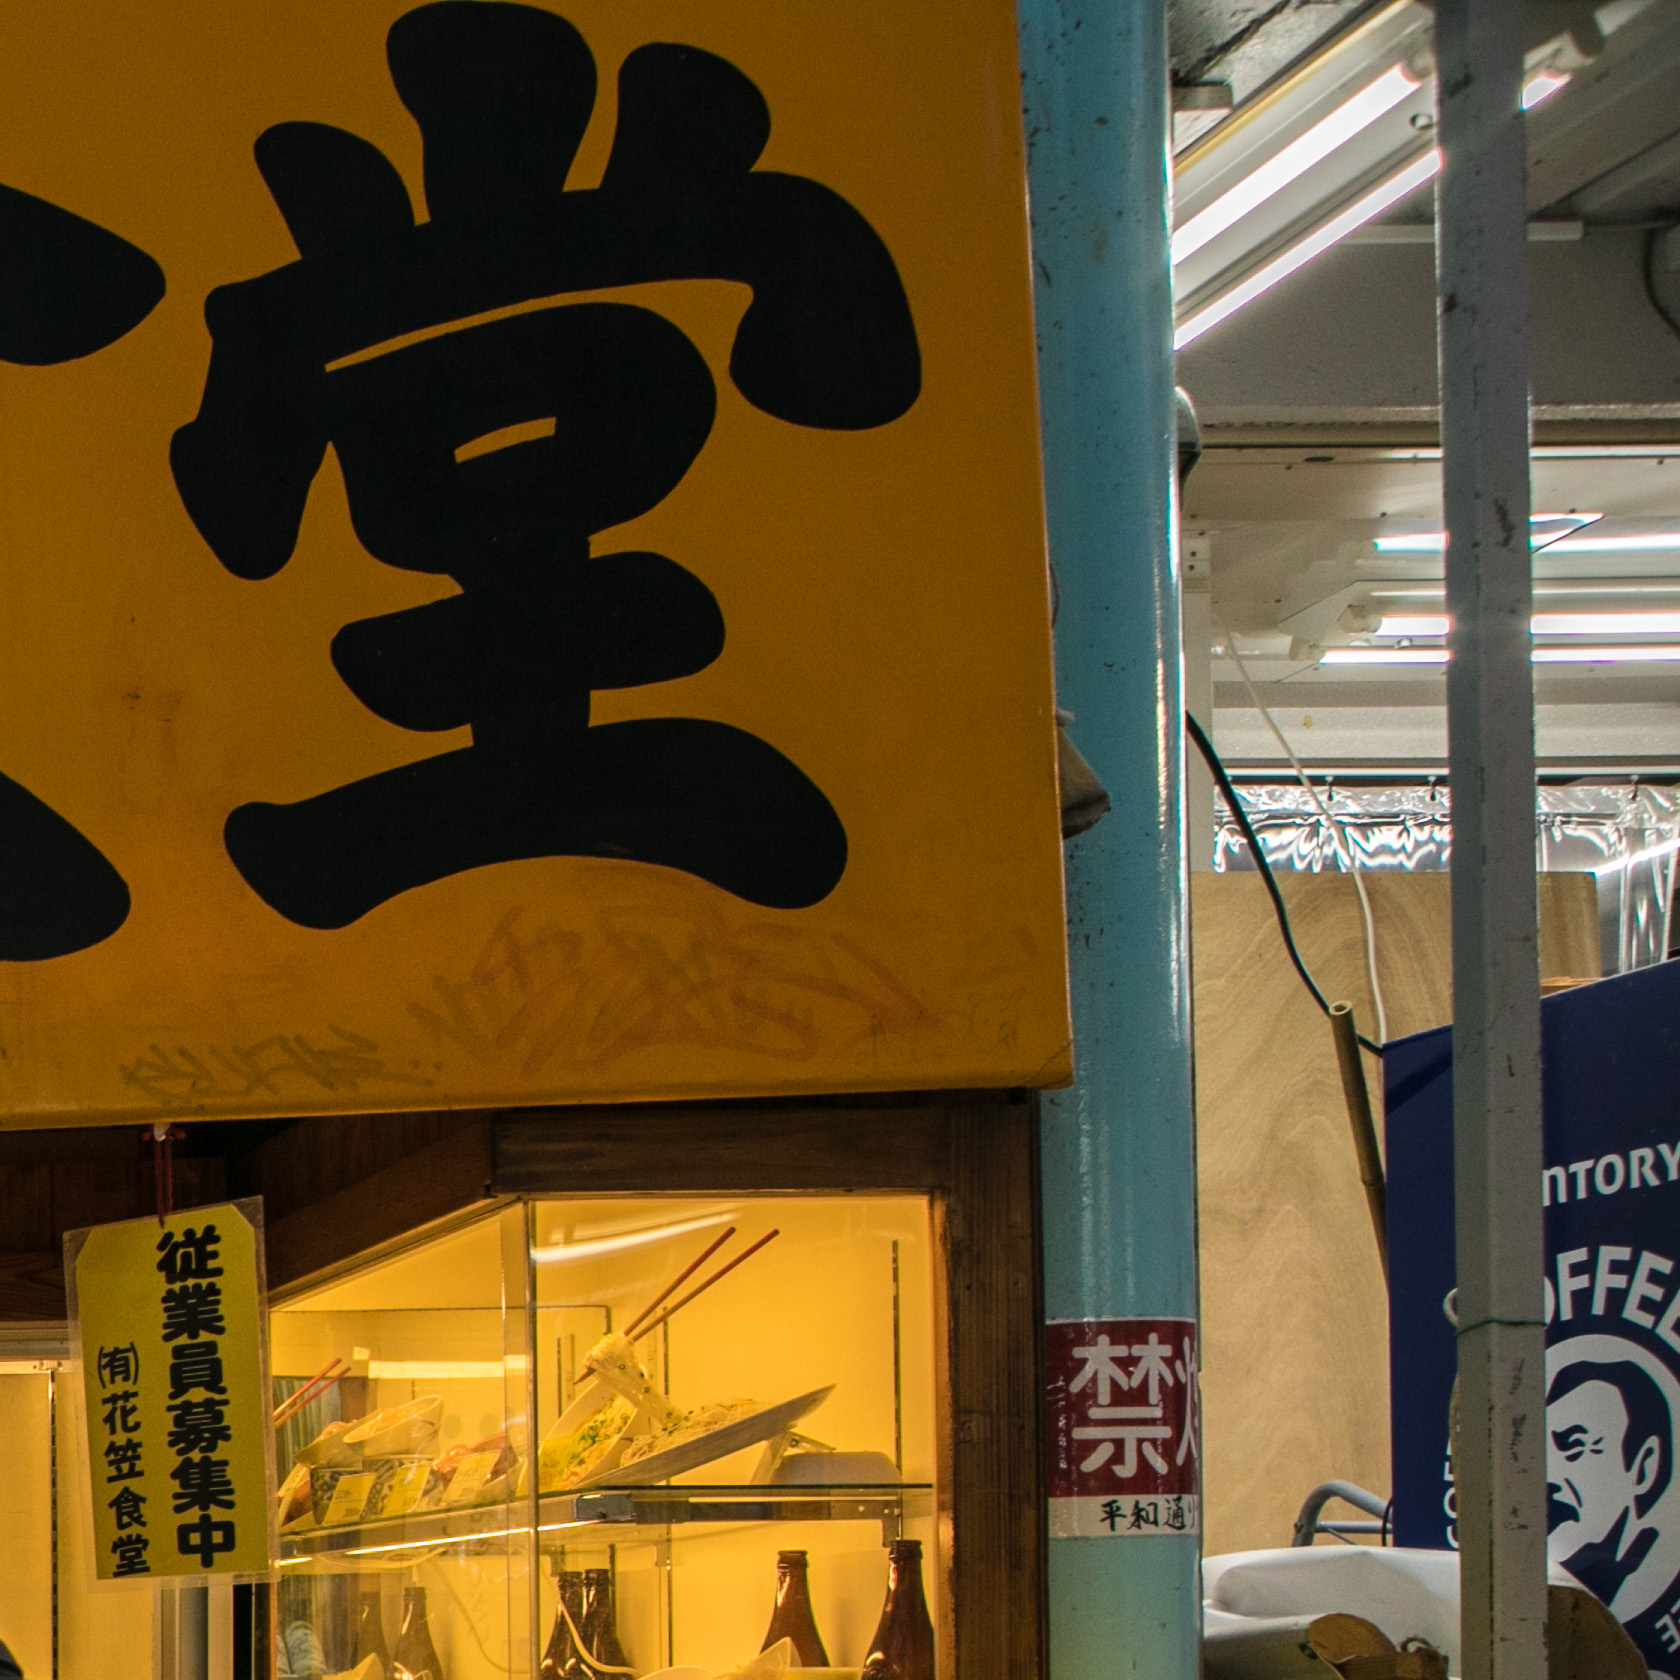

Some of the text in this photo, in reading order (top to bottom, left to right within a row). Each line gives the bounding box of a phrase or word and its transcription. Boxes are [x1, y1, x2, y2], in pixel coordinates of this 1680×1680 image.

[1542, 1140, 1680, 1207] NTORY
[156, 1224, 236, 1569] 従業員募集中
